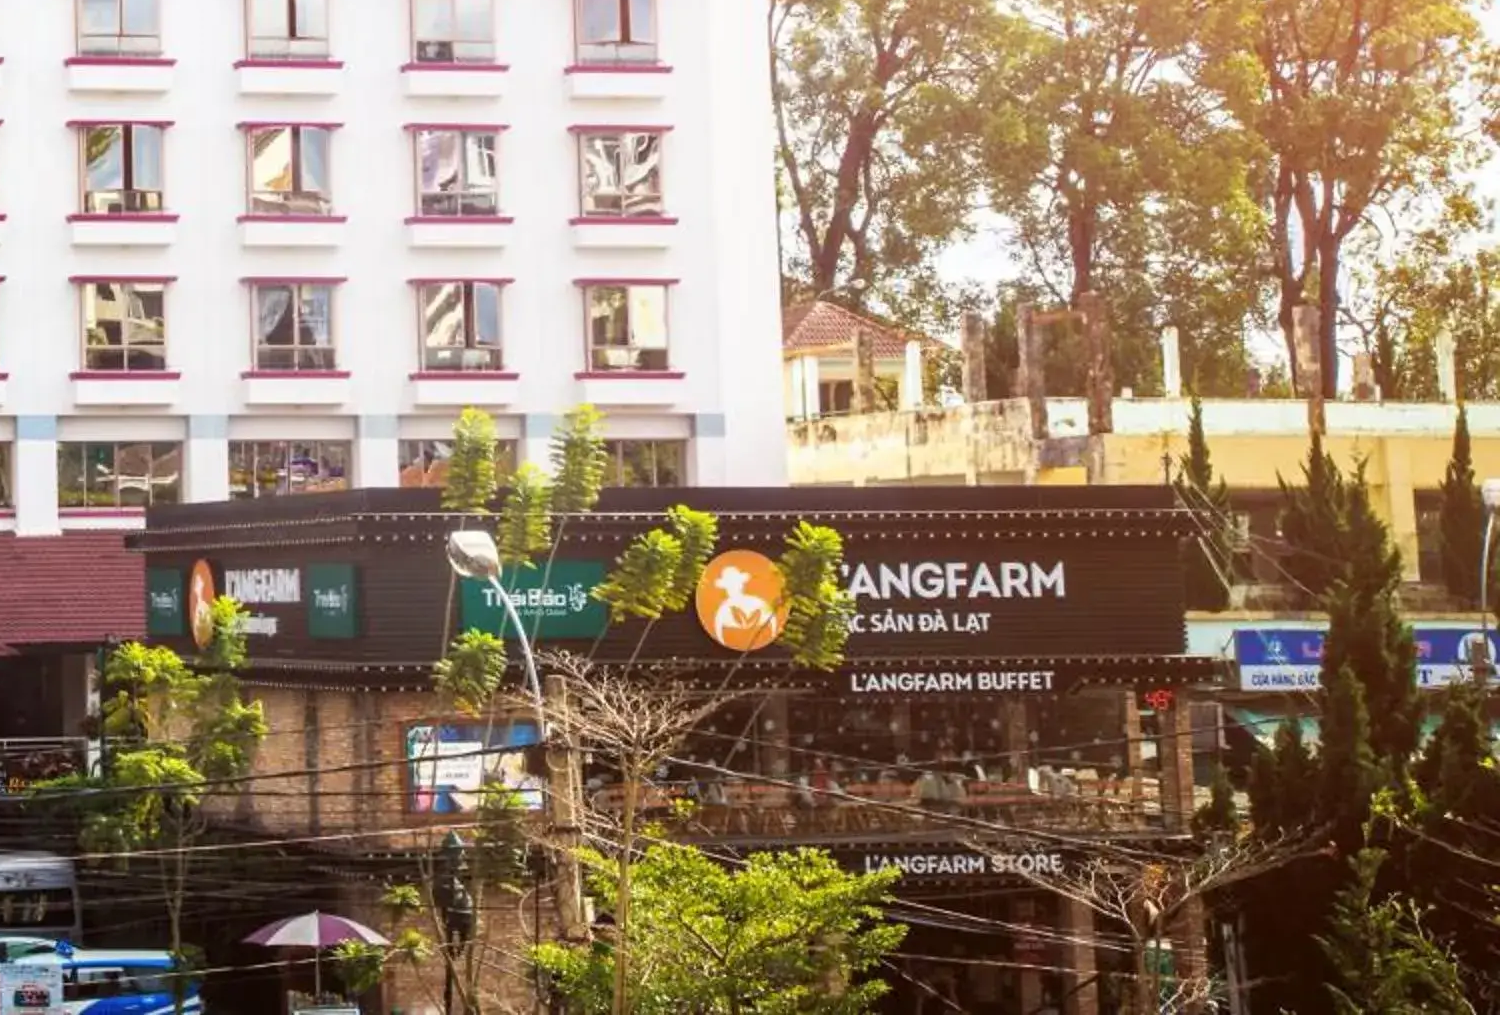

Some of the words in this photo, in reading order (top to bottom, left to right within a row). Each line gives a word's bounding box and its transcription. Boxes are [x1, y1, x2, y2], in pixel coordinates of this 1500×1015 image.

[839, 561, 1065, 600] 'ANGFARM
[870, 608, 913, 633] SẢN
[918, 609, 948, 633] ĐÀ
[953, 612, 991, 635] LẠT
[851, 673, 973, 693] L'ANGFARM
[977, 671, 1055, 691] BUFFET
[864, 853, 985, 874] L'ANGFARM
[991, 853, 1065, 874] STORE
